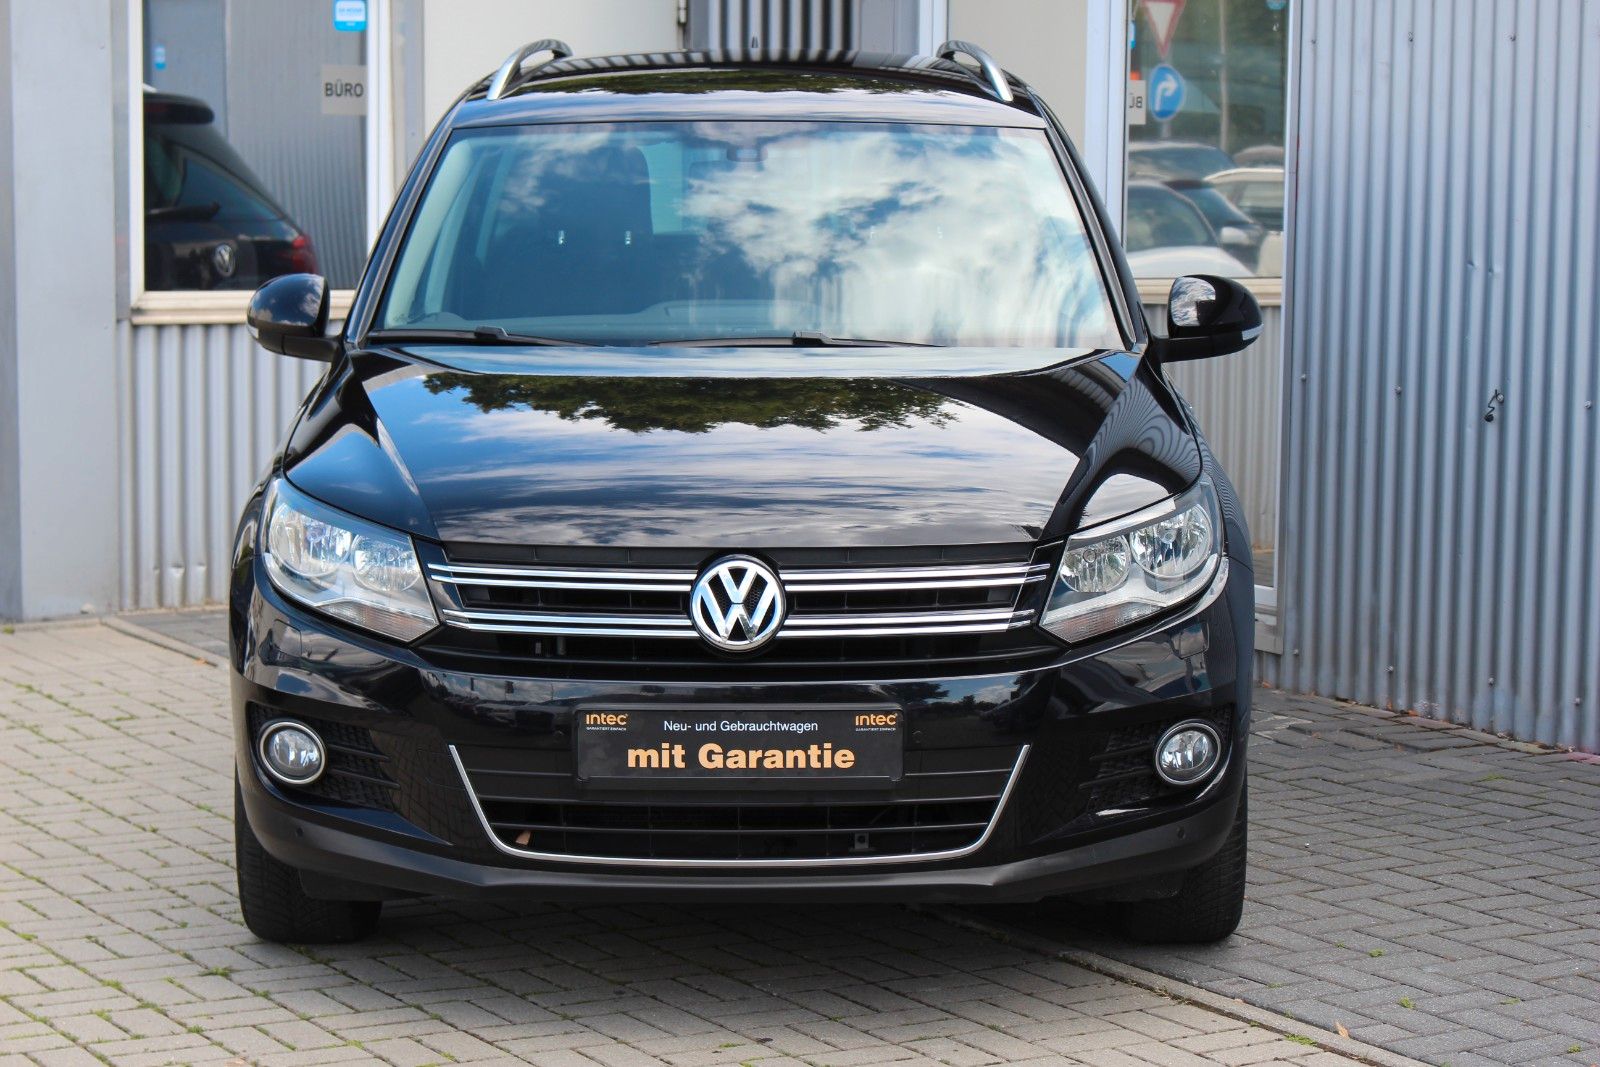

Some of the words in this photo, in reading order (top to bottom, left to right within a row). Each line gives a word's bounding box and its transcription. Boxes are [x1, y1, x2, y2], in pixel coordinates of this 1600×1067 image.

[324, 79, 364, 97] BÜRO
[692, 558, 783, 647] VW
[586, 713, 627, 725] intec
[664, 720, 692, 731] Neu-
[695, 720, 717, 731] und
[720, 720, 818, 733] Gebrauchtwagen
[855, 714, 897, 726] intec
[627, 742, 686, 768] mit
[698, 742, 855, 769] Garantie
